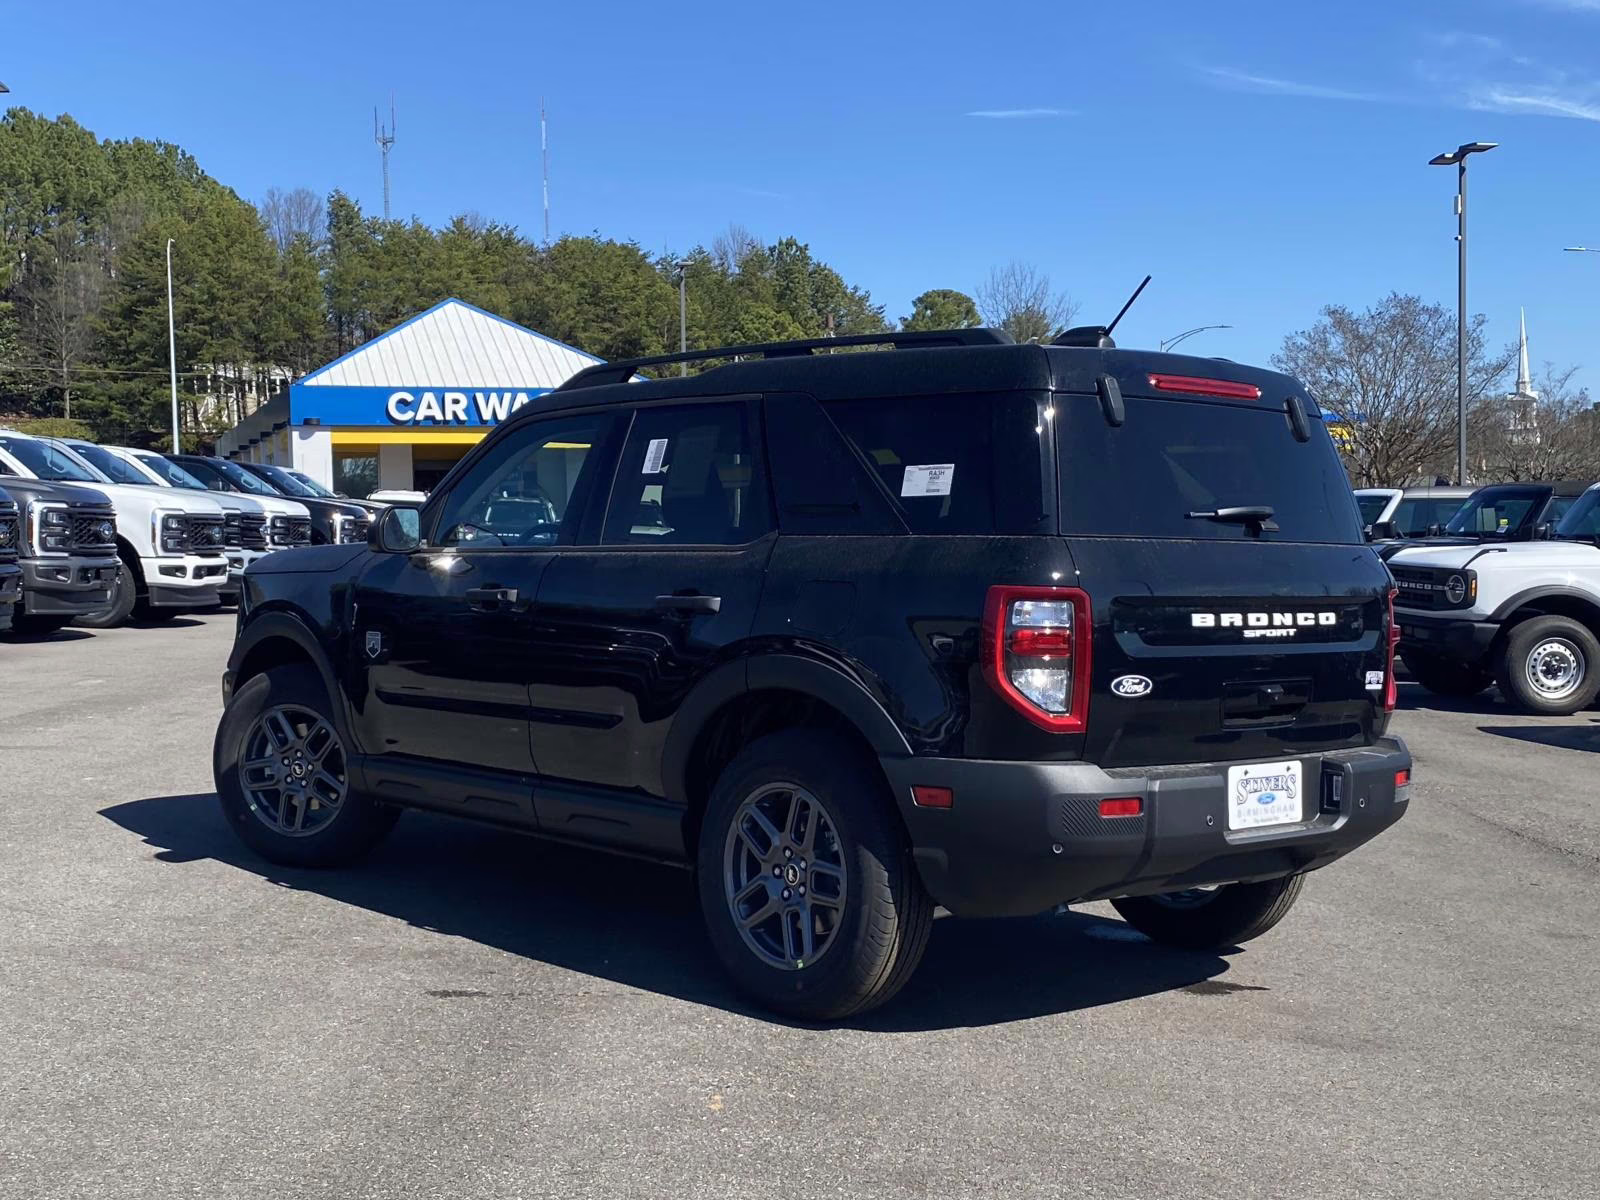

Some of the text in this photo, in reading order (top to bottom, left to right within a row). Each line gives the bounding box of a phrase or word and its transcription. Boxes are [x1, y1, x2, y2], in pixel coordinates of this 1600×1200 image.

[387, 391, 551, 422] CAR WA
[1191, 612, 1336, 627] BRONCO
[1243, 628, 1297, 638] SPORT
[1236, 774, 1297, 805] STIVERS
